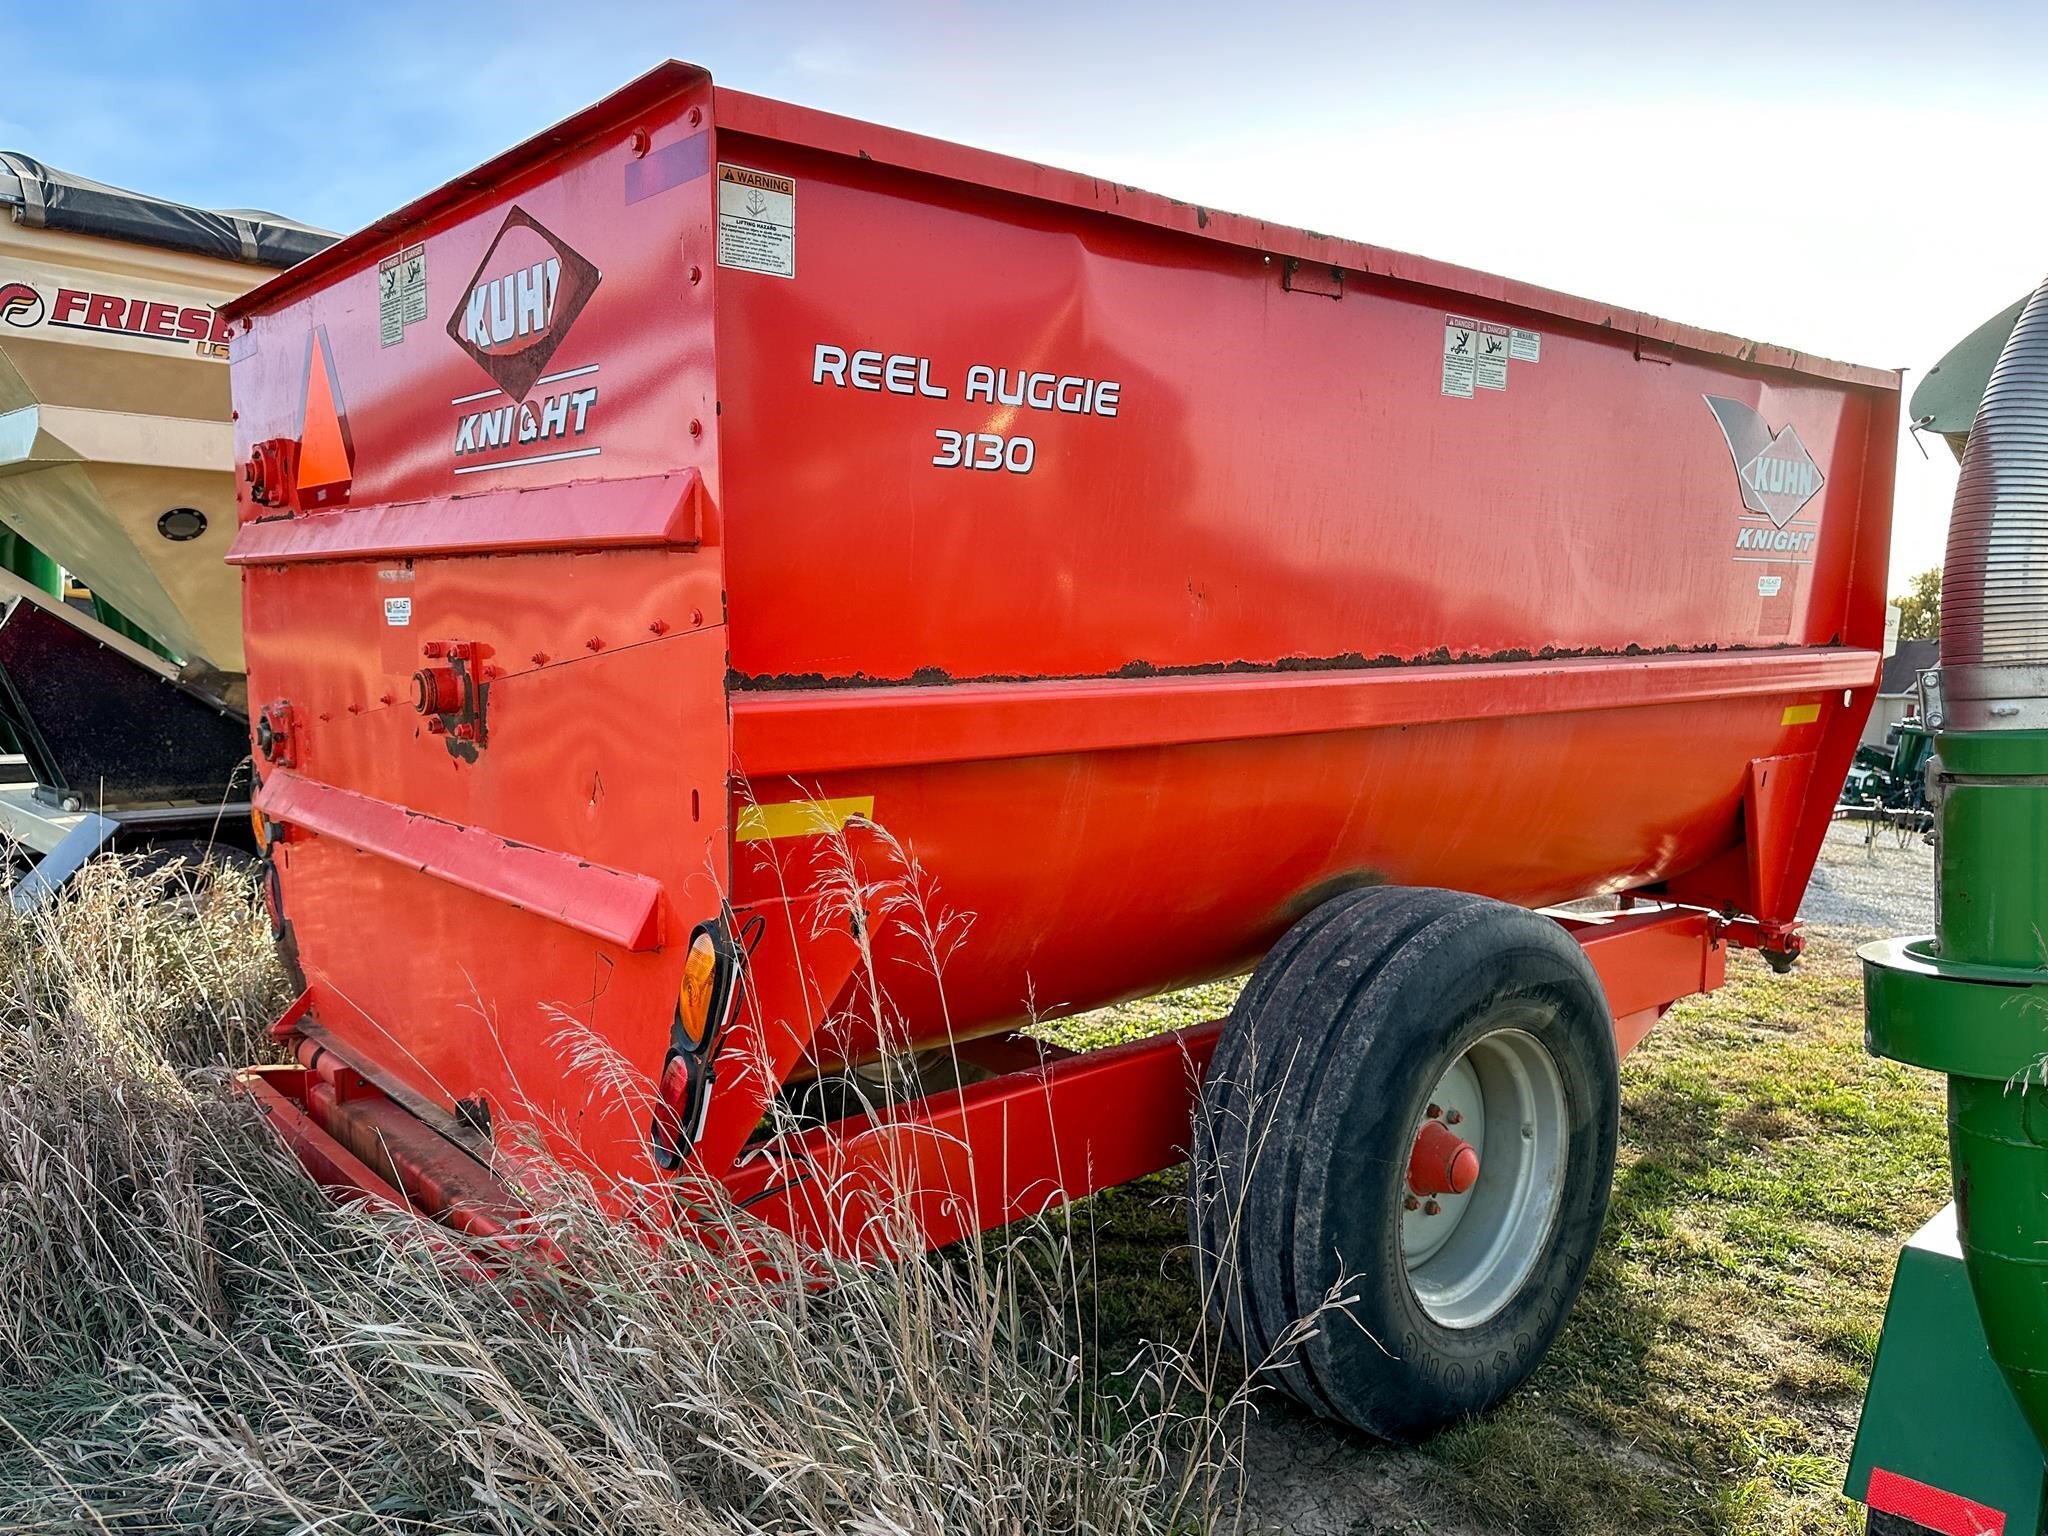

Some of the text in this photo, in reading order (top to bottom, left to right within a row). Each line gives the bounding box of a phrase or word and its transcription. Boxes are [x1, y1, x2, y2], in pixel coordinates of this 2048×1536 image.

[736, 171, 789, 192] WARNING
[736, 220, 777, 232] LIFTING HAZARD
[1454, 319, 1475, 330] DANGER
[1487, 325, 1507, 335] DANGER
[812, 344, 1121, 417] REEL AUGGIE
[455, 387, 598, 456] KNIGHT
[932, 429, 1035, 474] 3130
[1754, 456, 1815, 496] KUHN
[1735, 527, 1816, 554] KNIGHT
